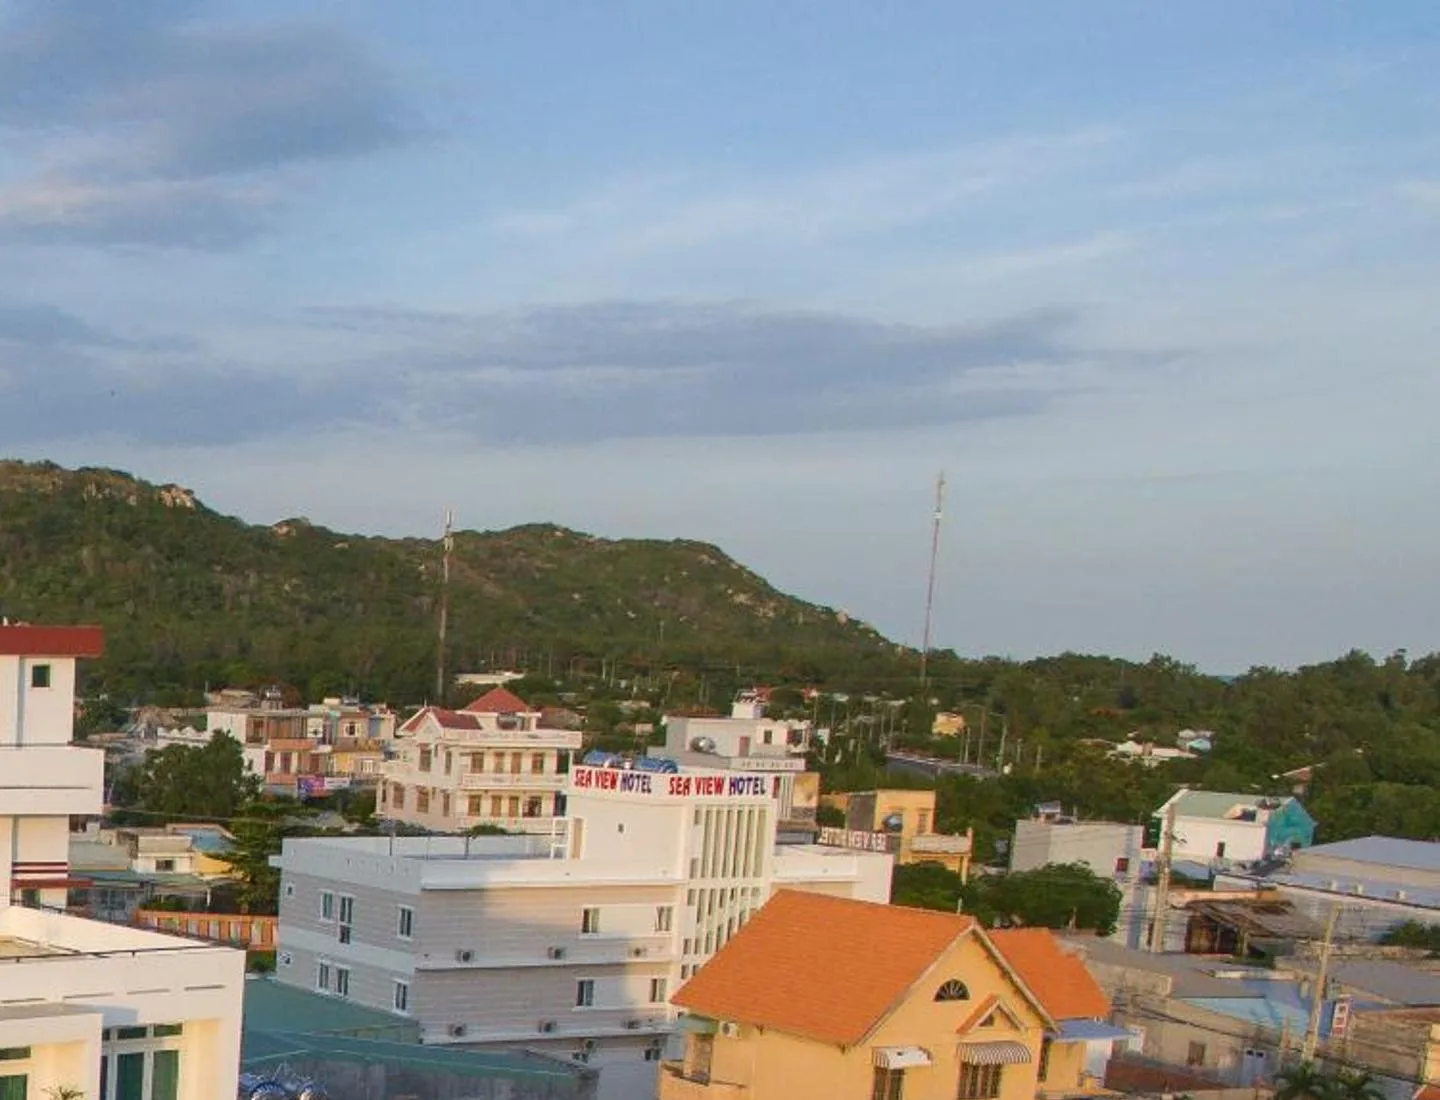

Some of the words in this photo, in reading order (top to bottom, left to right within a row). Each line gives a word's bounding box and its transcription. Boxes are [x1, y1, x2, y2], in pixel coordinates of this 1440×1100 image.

[574, 769, 593, 787] SEA
[594, 770, 619, 791] VIEW
[620, 776, 652, 793] HOTEL
[668, 777, 692, 795] SEA
[694, 777, 725, 796] VIEW
[728, 777, 767, 797] HOTEL
